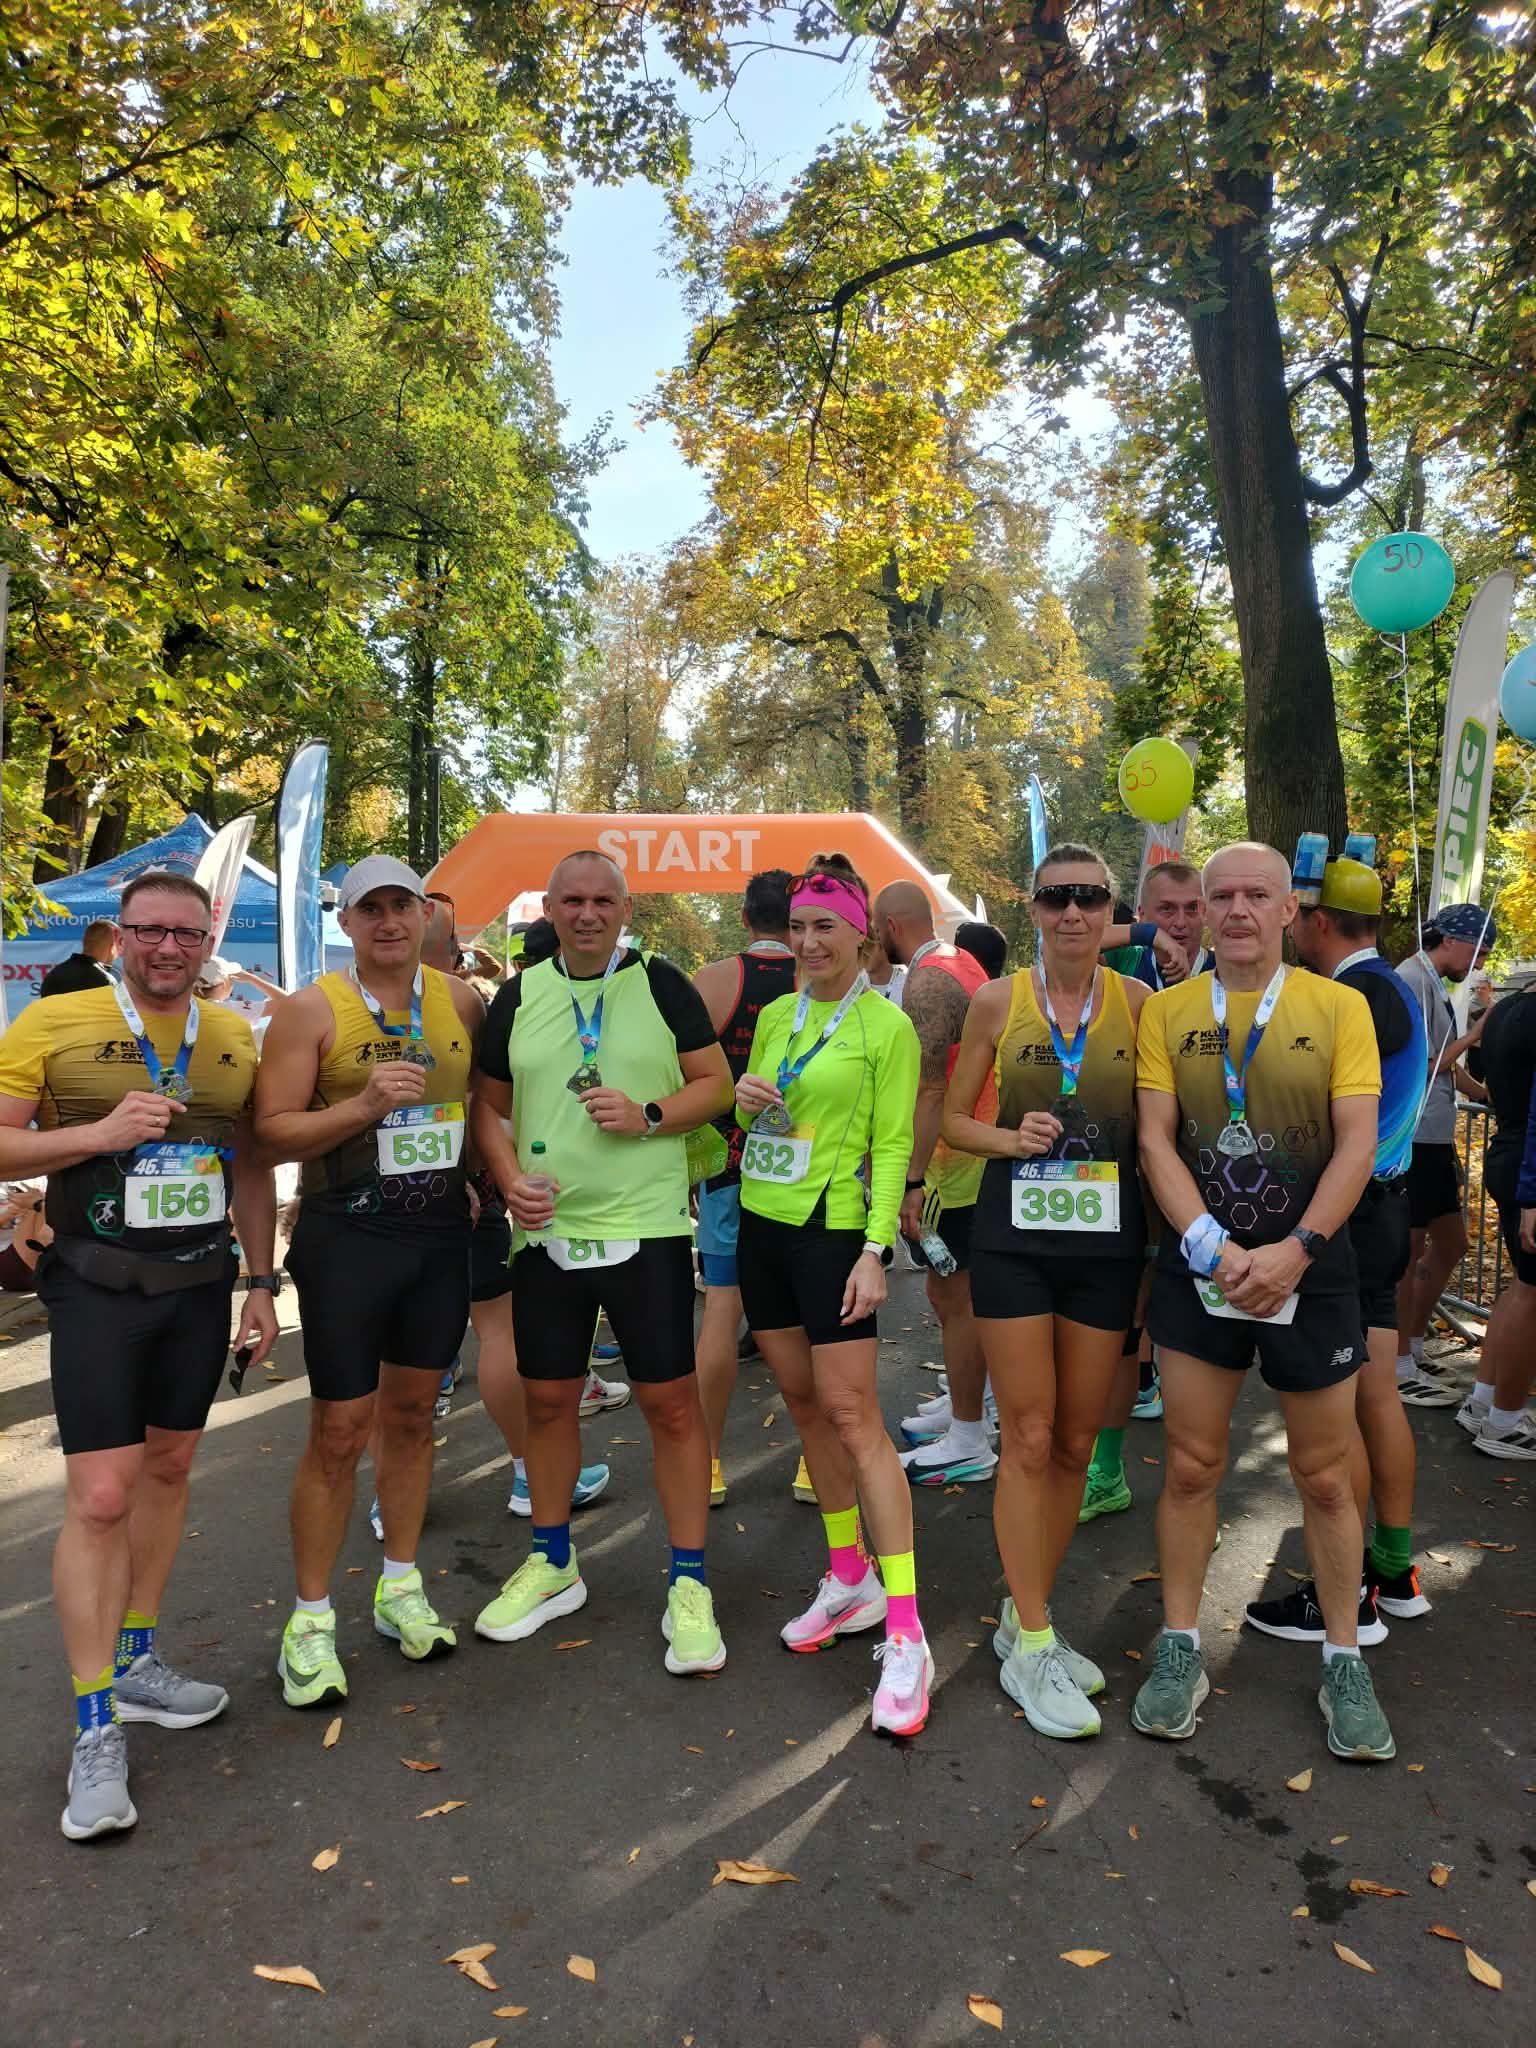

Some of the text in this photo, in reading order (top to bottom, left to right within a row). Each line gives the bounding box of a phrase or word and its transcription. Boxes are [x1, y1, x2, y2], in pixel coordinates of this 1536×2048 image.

[1383, 542, 1424, 573] 50
[1125, 759, 1158, 792] 55
[598, 829, 761, 873] START
[382, 1111, 406, 1127] 46.
[393, 1129, 452, 1167] 531
[744, 1140, 795, 1177] 532
[134, 1158, 160, 1176] 46.
[1019, 1163, 1041, 1179] 46.
[141, 1183, 210, 1219] 156
[1021, 1187, 1102, 1224] 396
